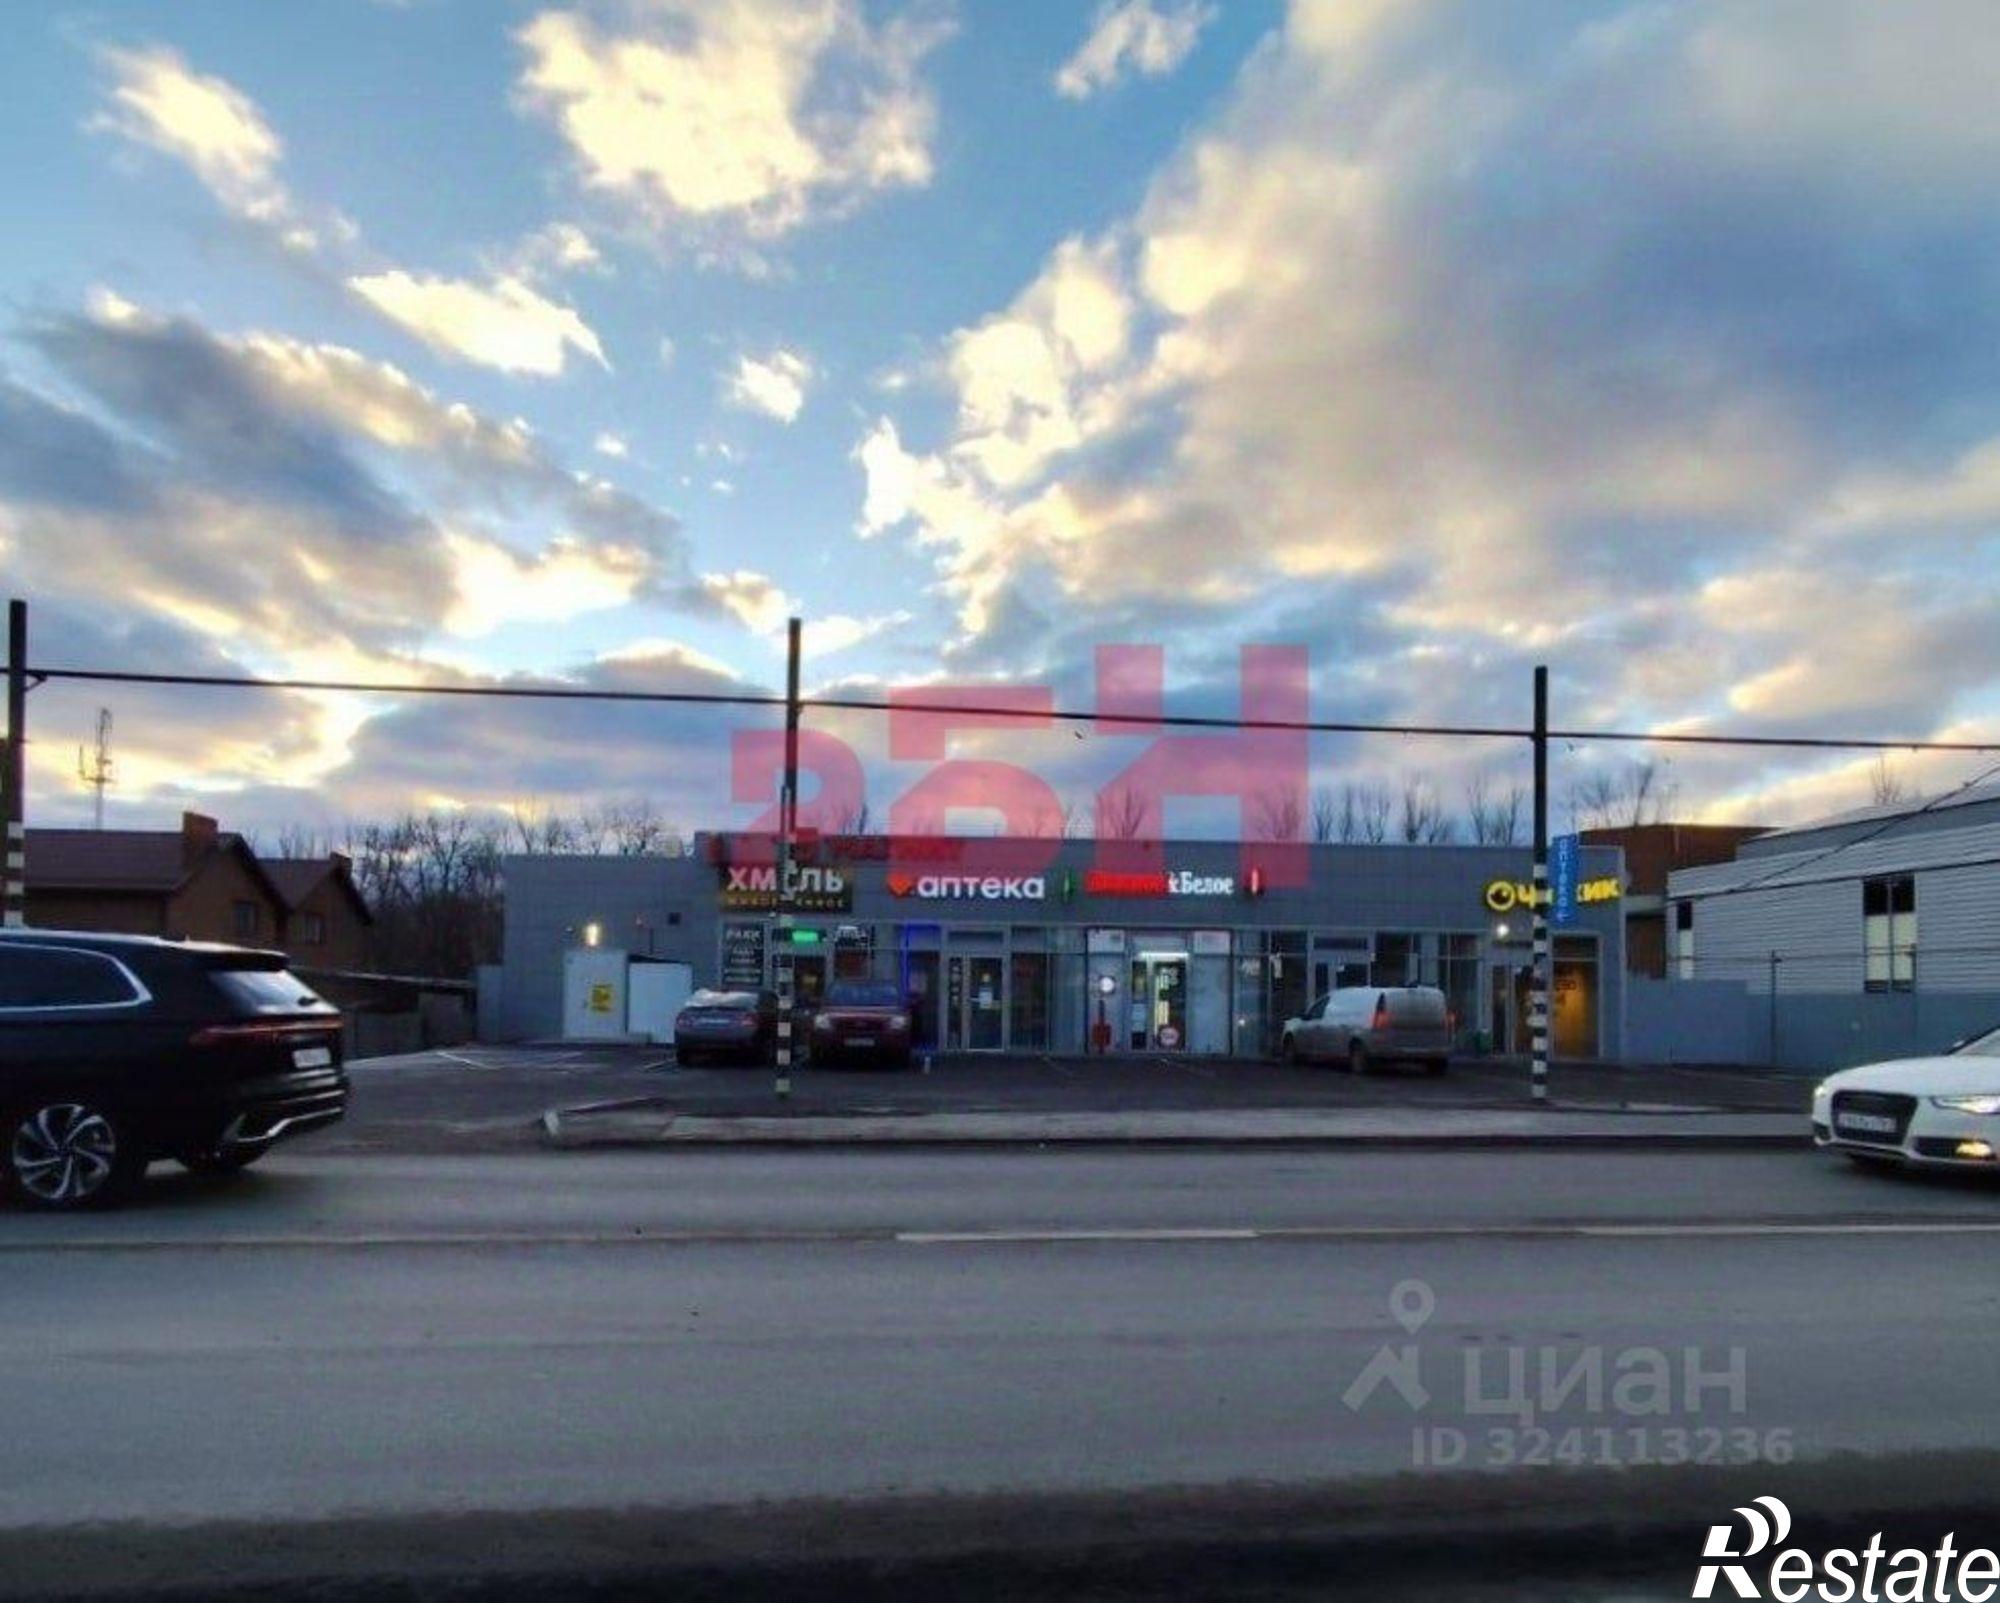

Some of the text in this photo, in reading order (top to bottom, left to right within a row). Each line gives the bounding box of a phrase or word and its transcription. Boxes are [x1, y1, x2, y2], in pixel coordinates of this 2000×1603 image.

[726, 866, 844, 893] ХМЛЬ
[916, 874, 1046, 900] аптека
[1517, 877, 1622, 909] ЧИК
